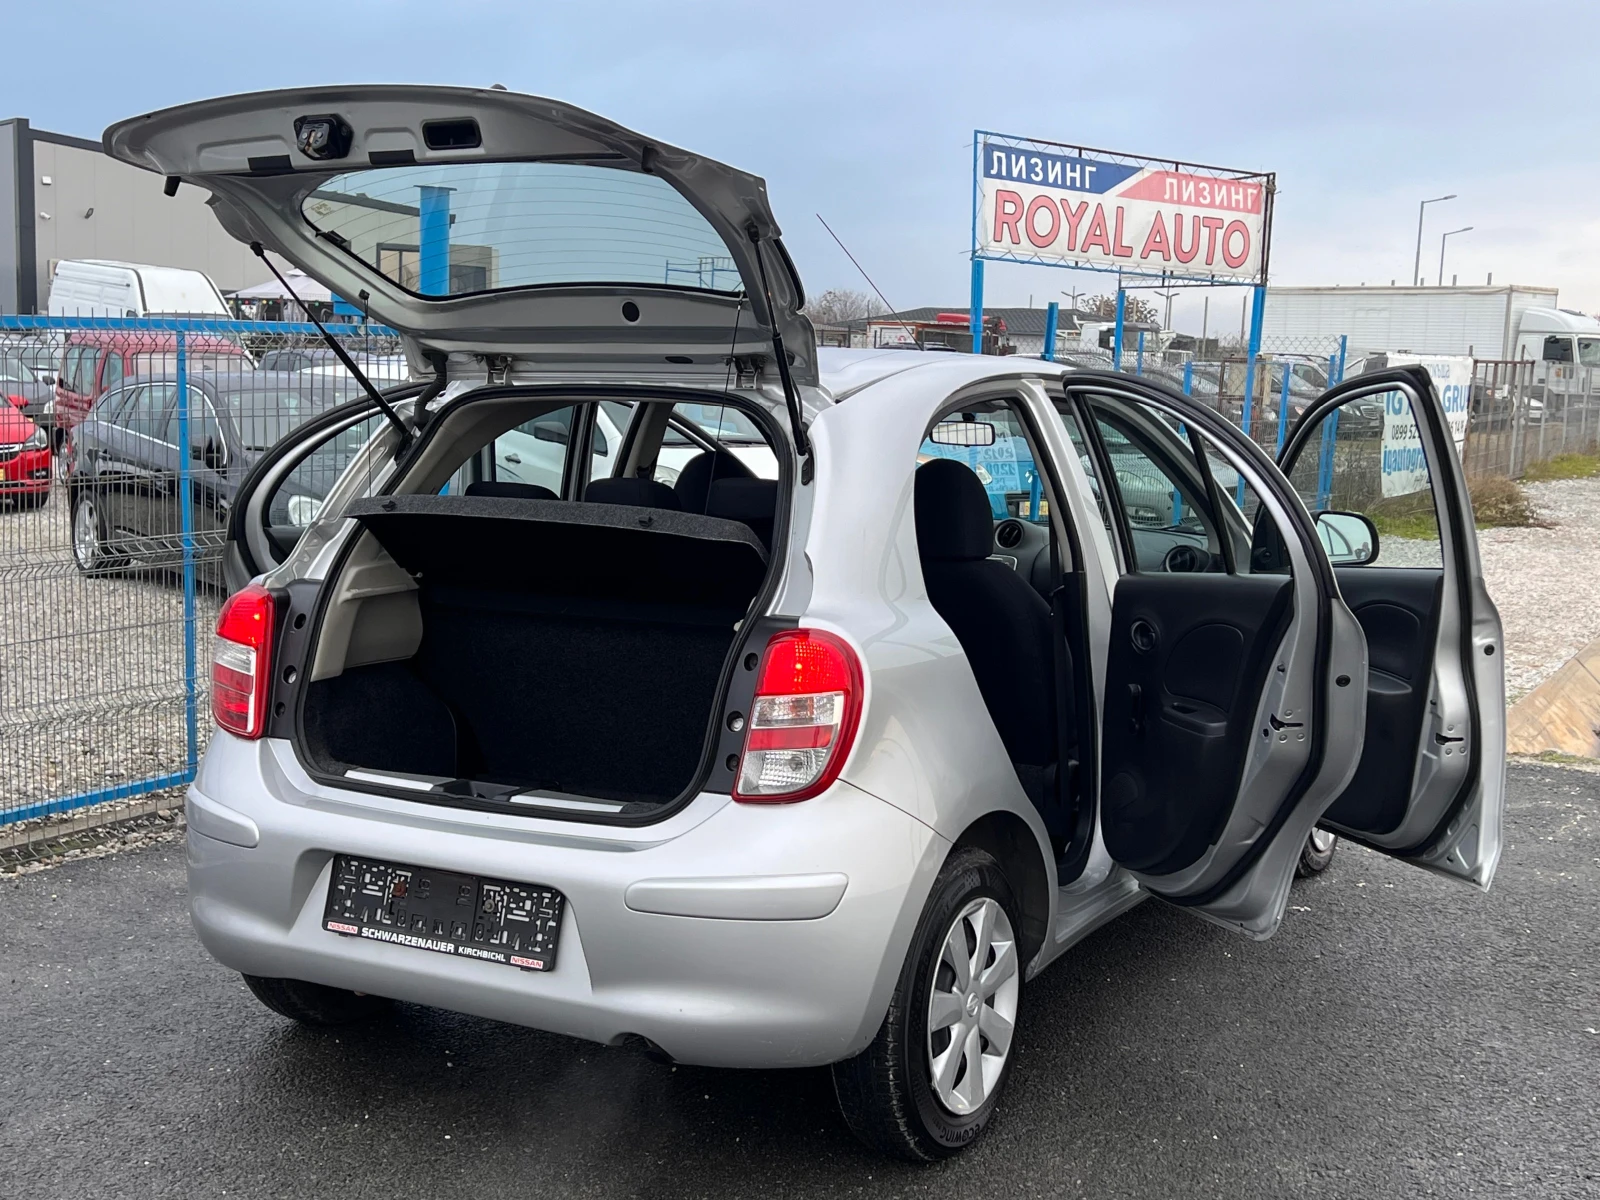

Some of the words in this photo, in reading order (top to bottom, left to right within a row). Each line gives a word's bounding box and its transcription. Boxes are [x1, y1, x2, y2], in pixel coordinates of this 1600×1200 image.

[990, 151, 1097, 189] ЛИЗИНГ
[1163, 178, 1257, 210] ЛИЗИНГ
[993, 189, 1133, 257] ROYAL
[1140, 210, 1250, 268] AUTO
[1391, 425, 1408, 441] 0899
[327, 921, 358, 934] NISSAN
[361, 927, 455, 953] SCHWARZENAUER
[458, 945, 506, 962] KIRCHBICHL
[511, 957, 542, 968] NISSAN
